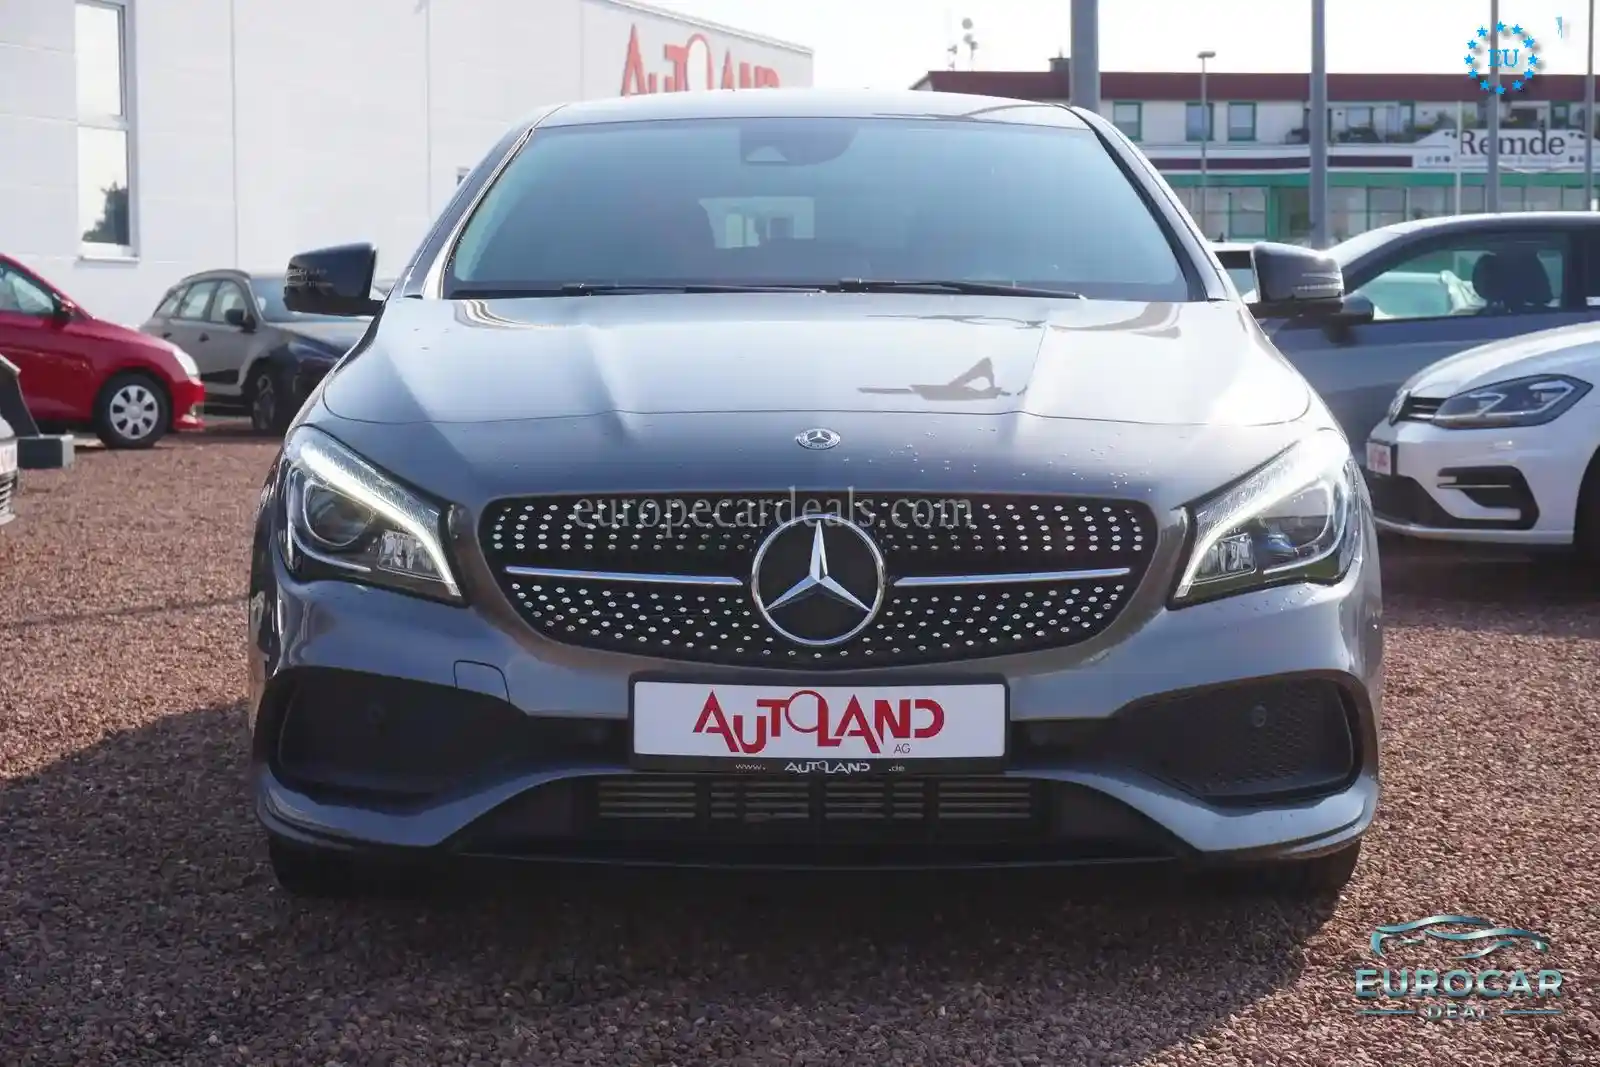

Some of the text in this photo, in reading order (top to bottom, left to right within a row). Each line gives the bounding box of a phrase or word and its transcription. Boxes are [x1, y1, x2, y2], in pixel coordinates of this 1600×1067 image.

[1460, 128, 1566, 156] Remde
[893, 743, 911, 755] AG
[735, 763, 767, 771] www.
[888, 764, 906, 773] .de
